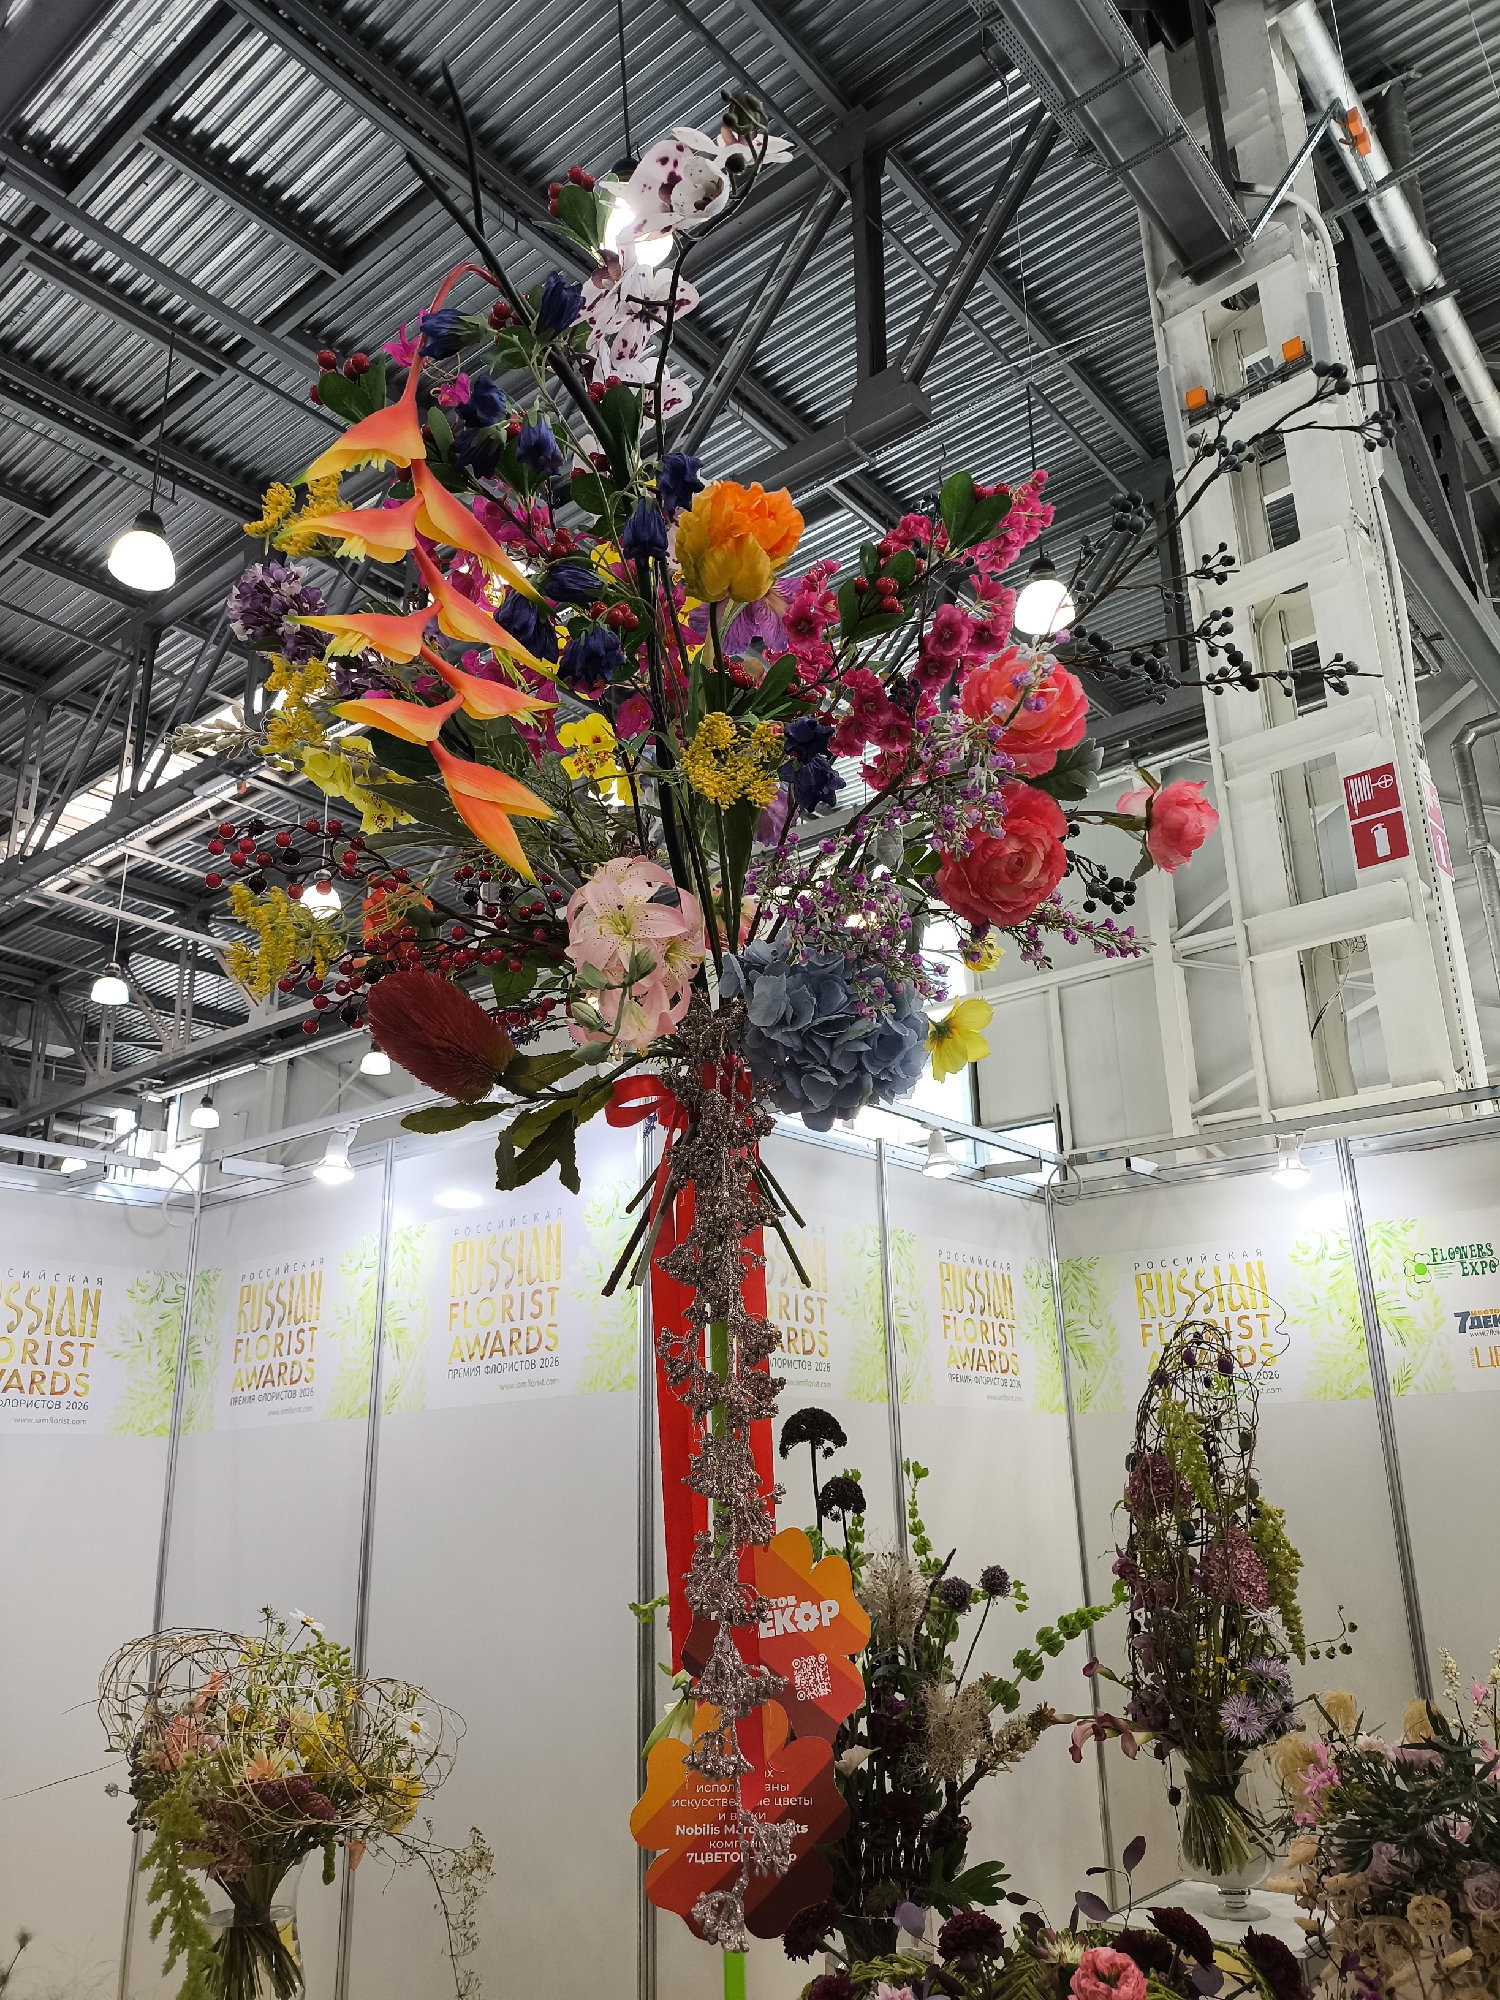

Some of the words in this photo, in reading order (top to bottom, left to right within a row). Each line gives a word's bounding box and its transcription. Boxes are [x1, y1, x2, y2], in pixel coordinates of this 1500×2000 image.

[454, 1208, 562, 1236] РОССИЙСКАЯ
[449, 1221, 562, 1297] RUSSIAN
[763, 1226, 827, 1293] SSIAN
[938, 1249, 1011, 1272] РОССИЙСКАЯ
[1133, 1248, 1263, 1271] РОССИЙСКАЯ
[1431, 1243, 1494, 1262] FLOWERS
[241, 1257, 324, 1282] РОССИЙСКАЯ
[1460, 1259, 1498, 1277] EXPO
[236, 1269, 323, 1335] RUSSIAN
[938, 1261, 1016, 1320] RUSSIAN
[1134, 1260, 1270, 1320] RUSSIAN
[0, 1281, 102, 1338] SSIAN
[448, 1287, 559, 1331] FLORIST
[767, 1291, 828, 1325] RIST
[233, 1326, 318, 1364] FLORIST
[448, 1323, 559, 1364] AWARDS
[942, 1315, 1016, 1348] FLORIST
[447, 1364, 481, 1379] ПРЕМИЯ
[484, 1358, 537, 1375] ФЛОРИСТОВ
[539, 1356, 560, 1369] 2026
[769, 1358, 812, 1371] ЛОРИСТОВ
[815, 1361, 831, 1373] 2026
[946, 1344, 1020, 1377] AWARDS
[1146, 1342, 1277, 1375] AADS
[0, 1369, 90, 1397] ARDS
[231, 1357, 315, 1393] AWARDS
[1257, 1370, 1280, 1381] 2026
[65, 1401, 89, 1411] 2026
[299, 1387, 314, 1398] 2026
[773, 1595, 797, 1608] ТОВ
[759, 1599, 840, 1639] ЕКОР
[774, 1796, 812, 1807] цветы
[676, 1824, 720, 1836] Nobilis
[718, 1812, 726, 1821] и
[730, 1812, 767, 1821] вки
